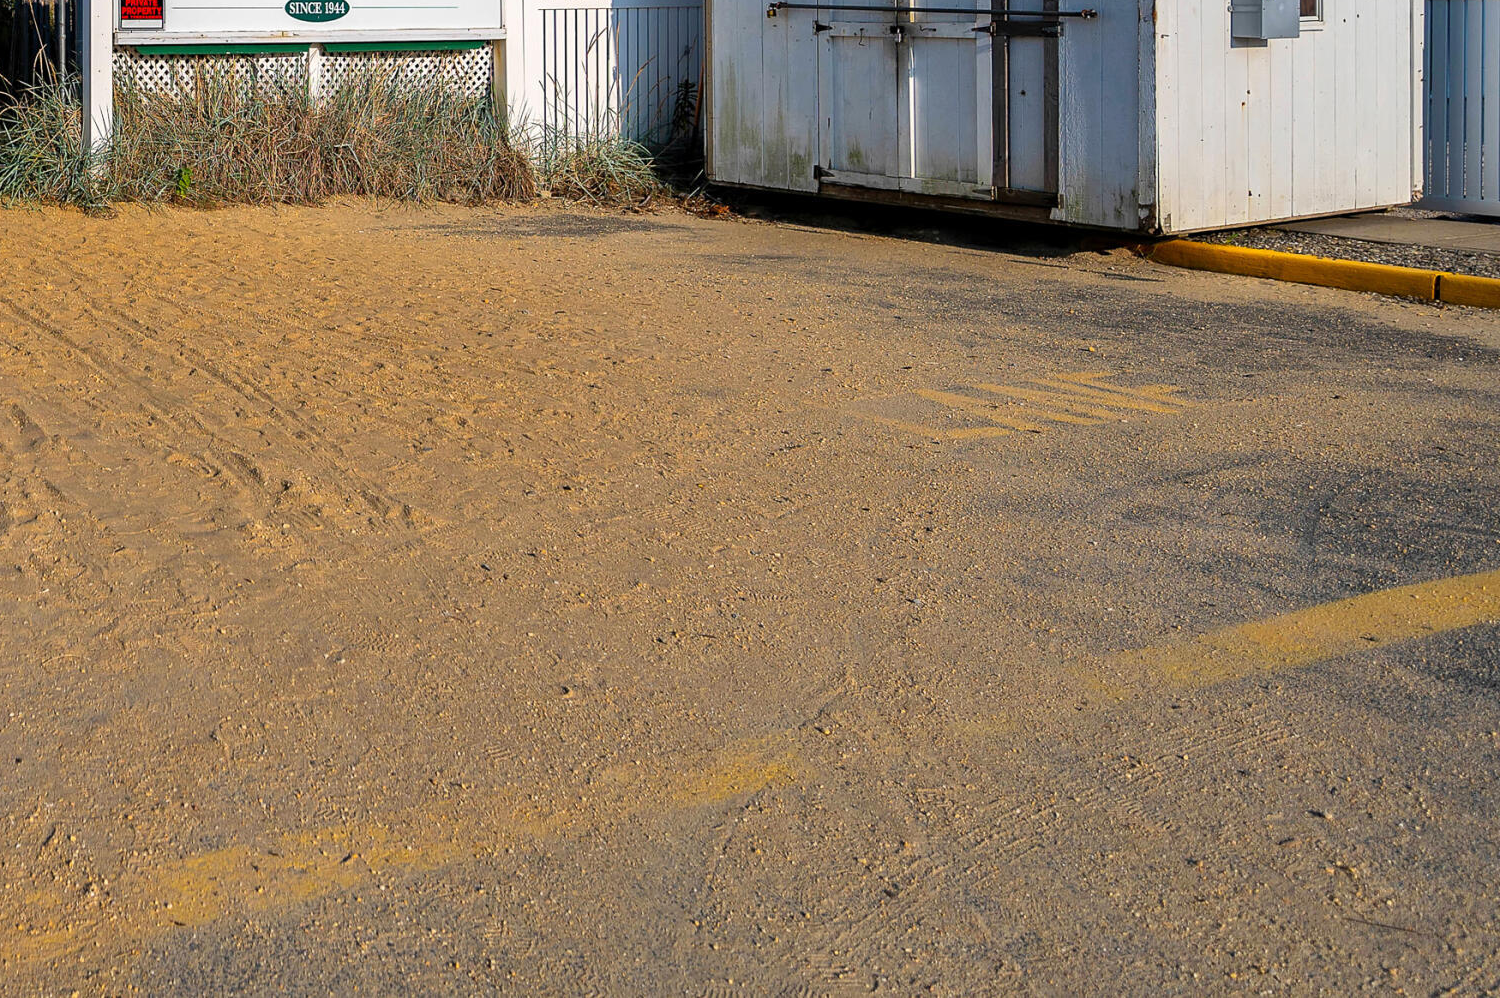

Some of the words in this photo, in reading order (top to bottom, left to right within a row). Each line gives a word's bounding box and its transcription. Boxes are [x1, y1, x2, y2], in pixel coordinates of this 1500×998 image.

[121, 6, 162, 16] PROPERTY
[289, 1, 322, 14] SINCE
[324, 1, 345, 14] 1944
